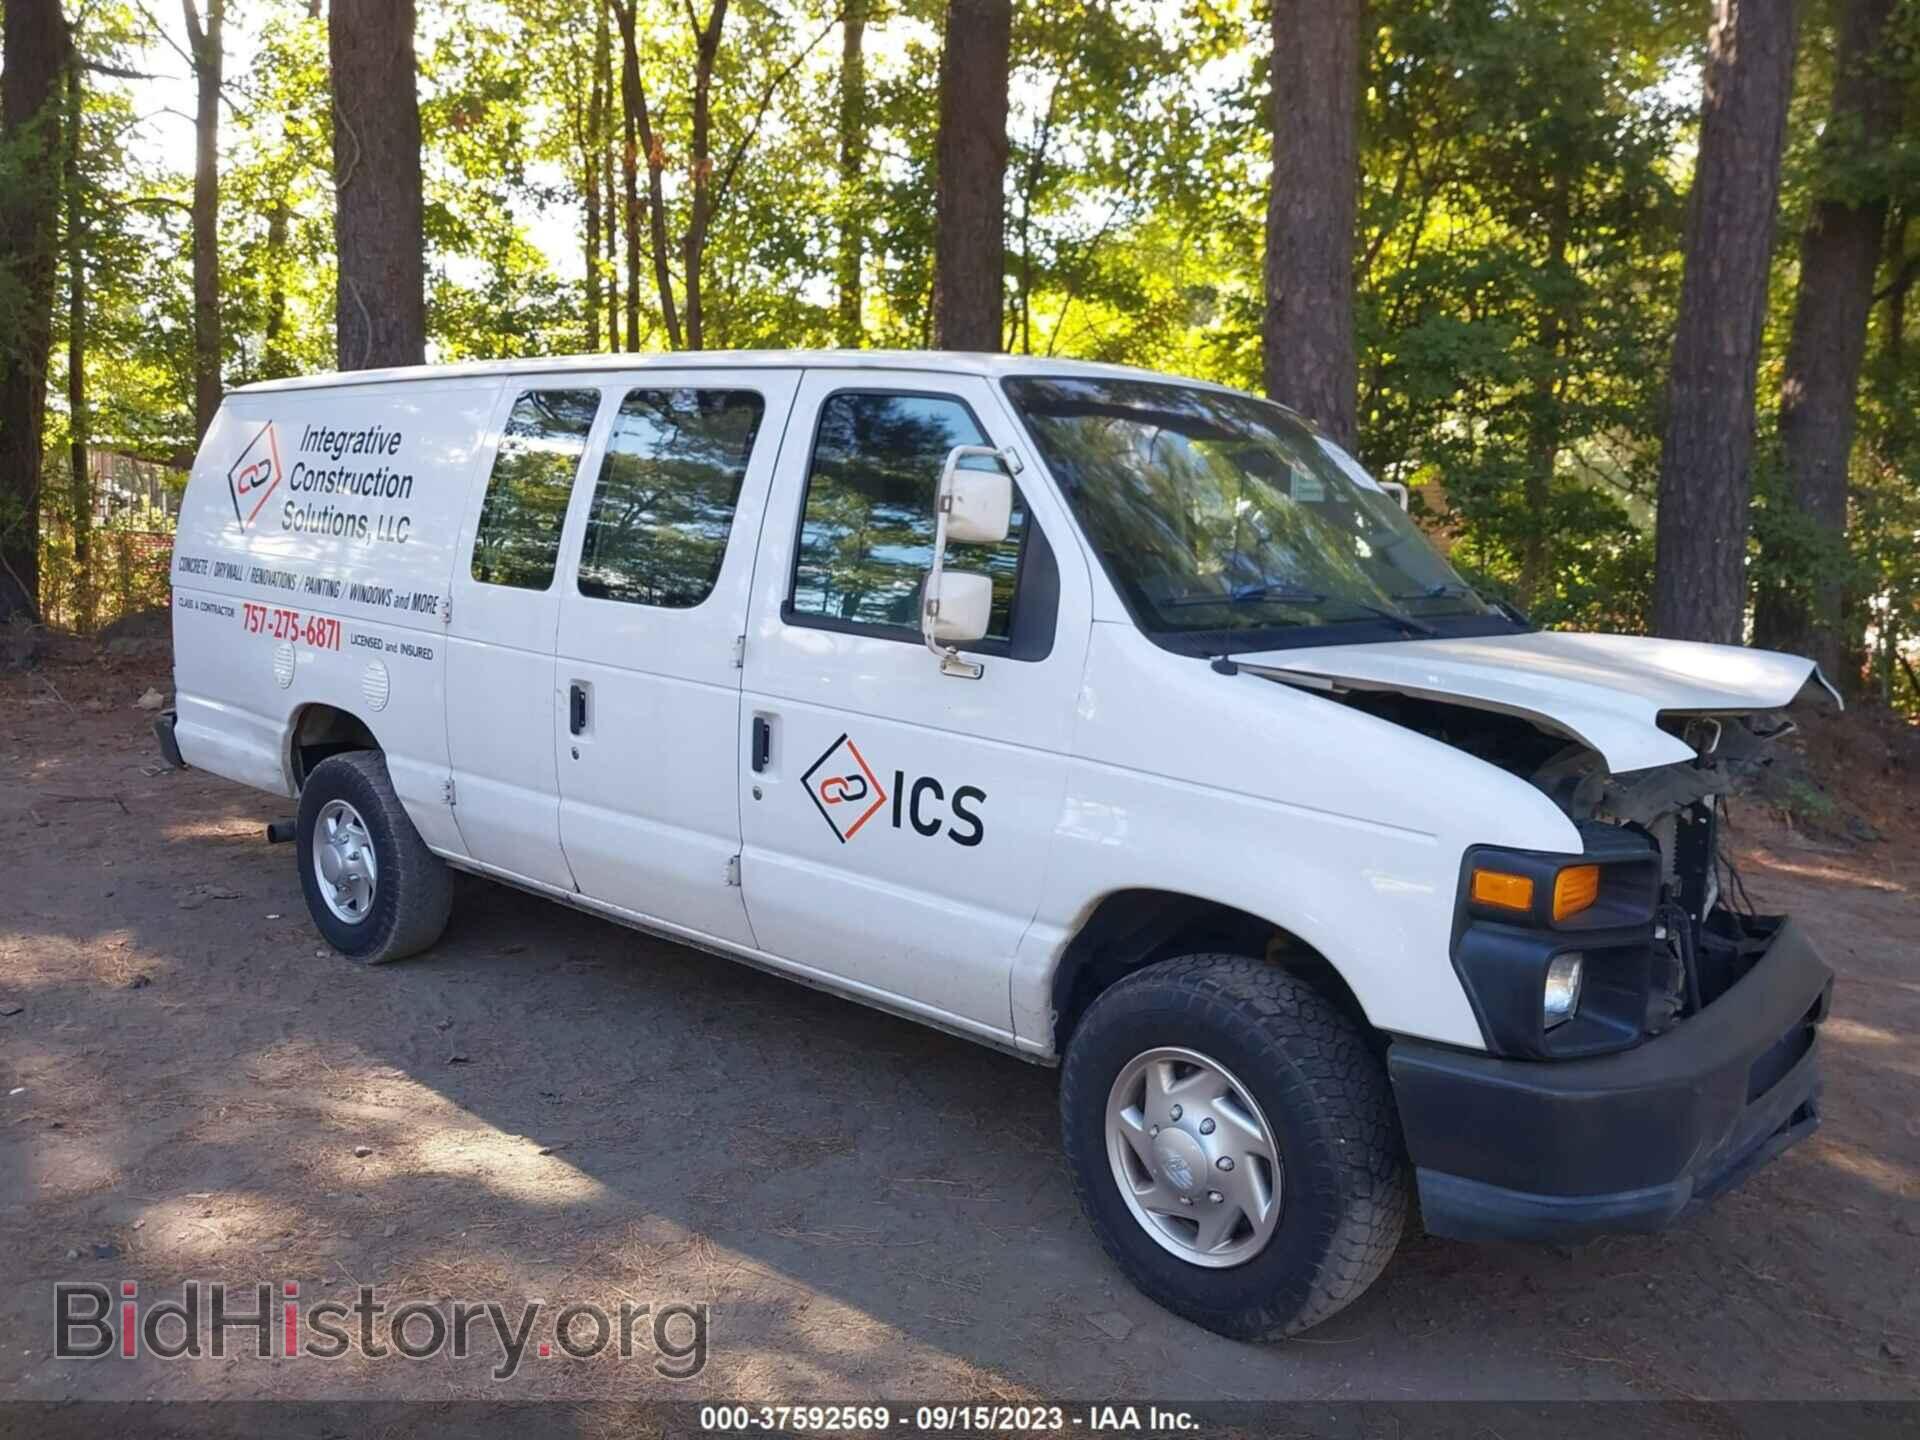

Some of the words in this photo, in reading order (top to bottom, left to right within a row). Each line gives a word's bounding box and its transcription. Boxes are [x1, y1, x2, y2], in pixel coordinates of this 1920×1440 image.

[300, 424, 402, 461] Integrative
[290, 462, 413, 499] Construction
[282, 500, 370, 545] Solutions,
[376, 514, 411, 543] LLC
[179, 556, 208, 575] CONCRETE
[214, 561, 243, 581] DRYWALL
[251, 567, 297, 590] RENOVATIONS
[304, 576, 341, 598] PAINTING
[349, 583, 393, 607] WINDOWS
[394, 592, 411, 609] and
[410, 592, 439, 614] MORE
[200, 601, 235, 617] CONTRACTOR
[243, 603, 341, 651] 757-275-6871
[350, 632, 383, 650] LICENSED
[385, 642, 398, 653] and
[400, 643, 433, 660] INSURED
[892, 770, 987, 846] ICS
